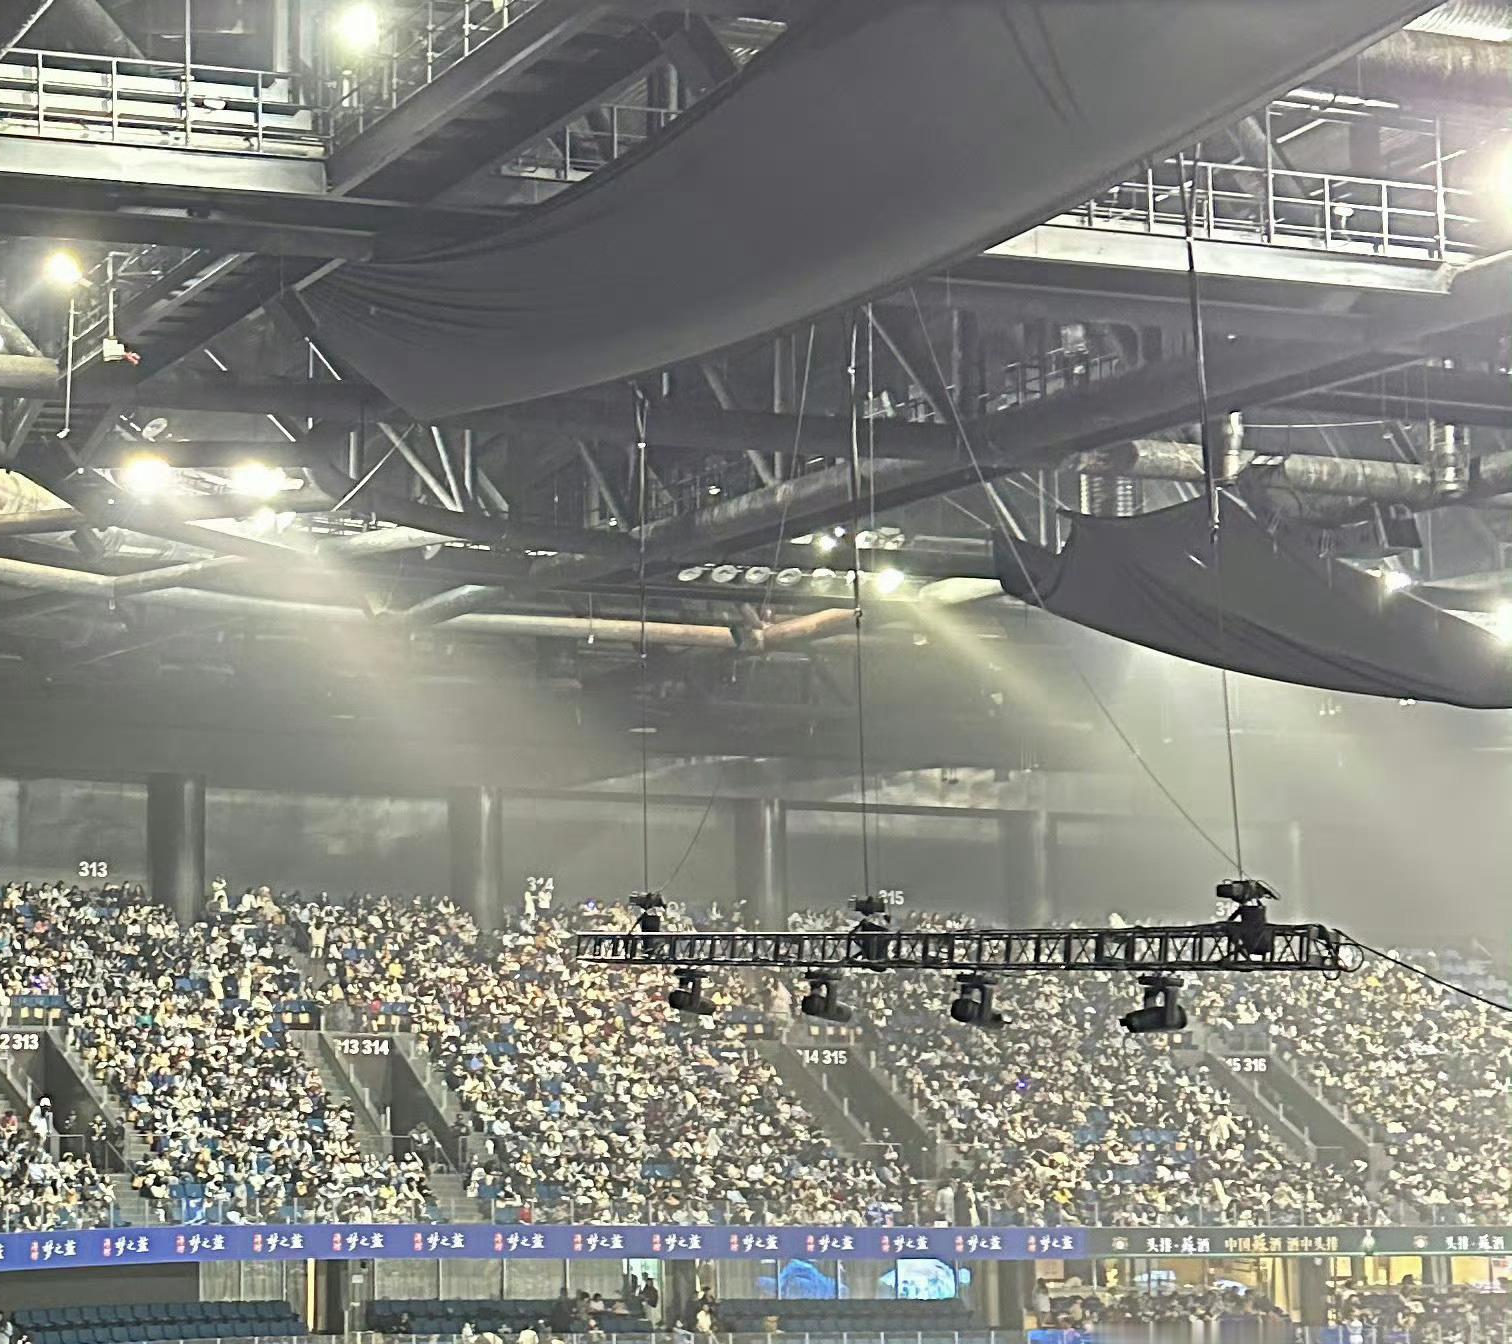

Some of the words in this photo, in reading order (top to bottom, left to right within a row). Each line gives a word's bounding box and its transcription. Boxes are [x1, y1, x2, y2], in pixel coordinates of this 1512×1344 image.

[78, 860, 108, 878] 313
[12, 1033, 39, 1050] 313
[362, 1039, 390, 1055] 314
[822, 1049, 848, 1065] 315
[1243, 1057, 1267, 1072] 316
